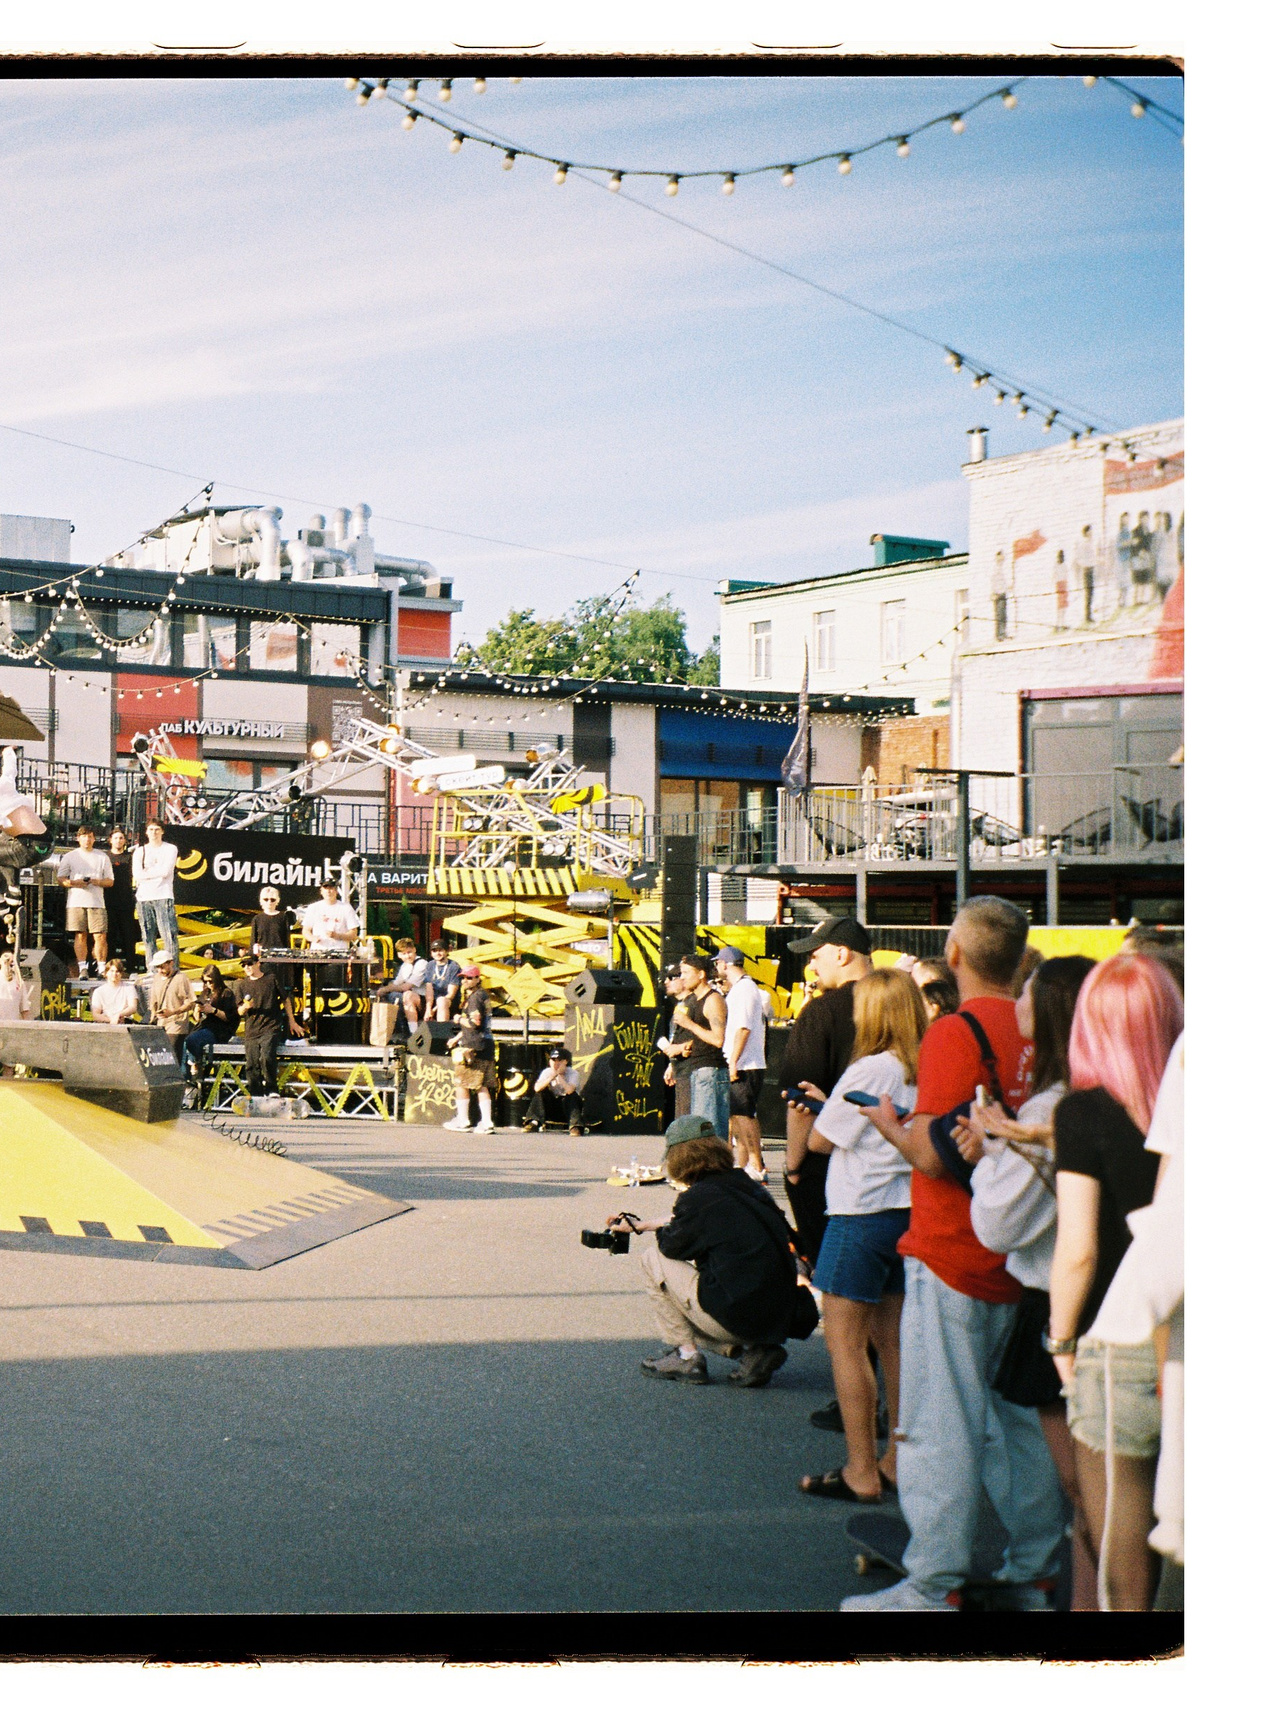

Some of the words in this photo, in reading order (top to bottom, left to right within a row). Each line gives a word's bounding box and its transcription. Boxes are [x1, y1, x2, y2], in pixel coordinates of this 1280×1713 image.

[160, 722, 183, 733] ПАБ
[184, 719, 284, 739] КУЛЬТУРНЫЙ
[213, 851, 322, 887] билайн
[381, 872, 429, 885] ВАРИТ
